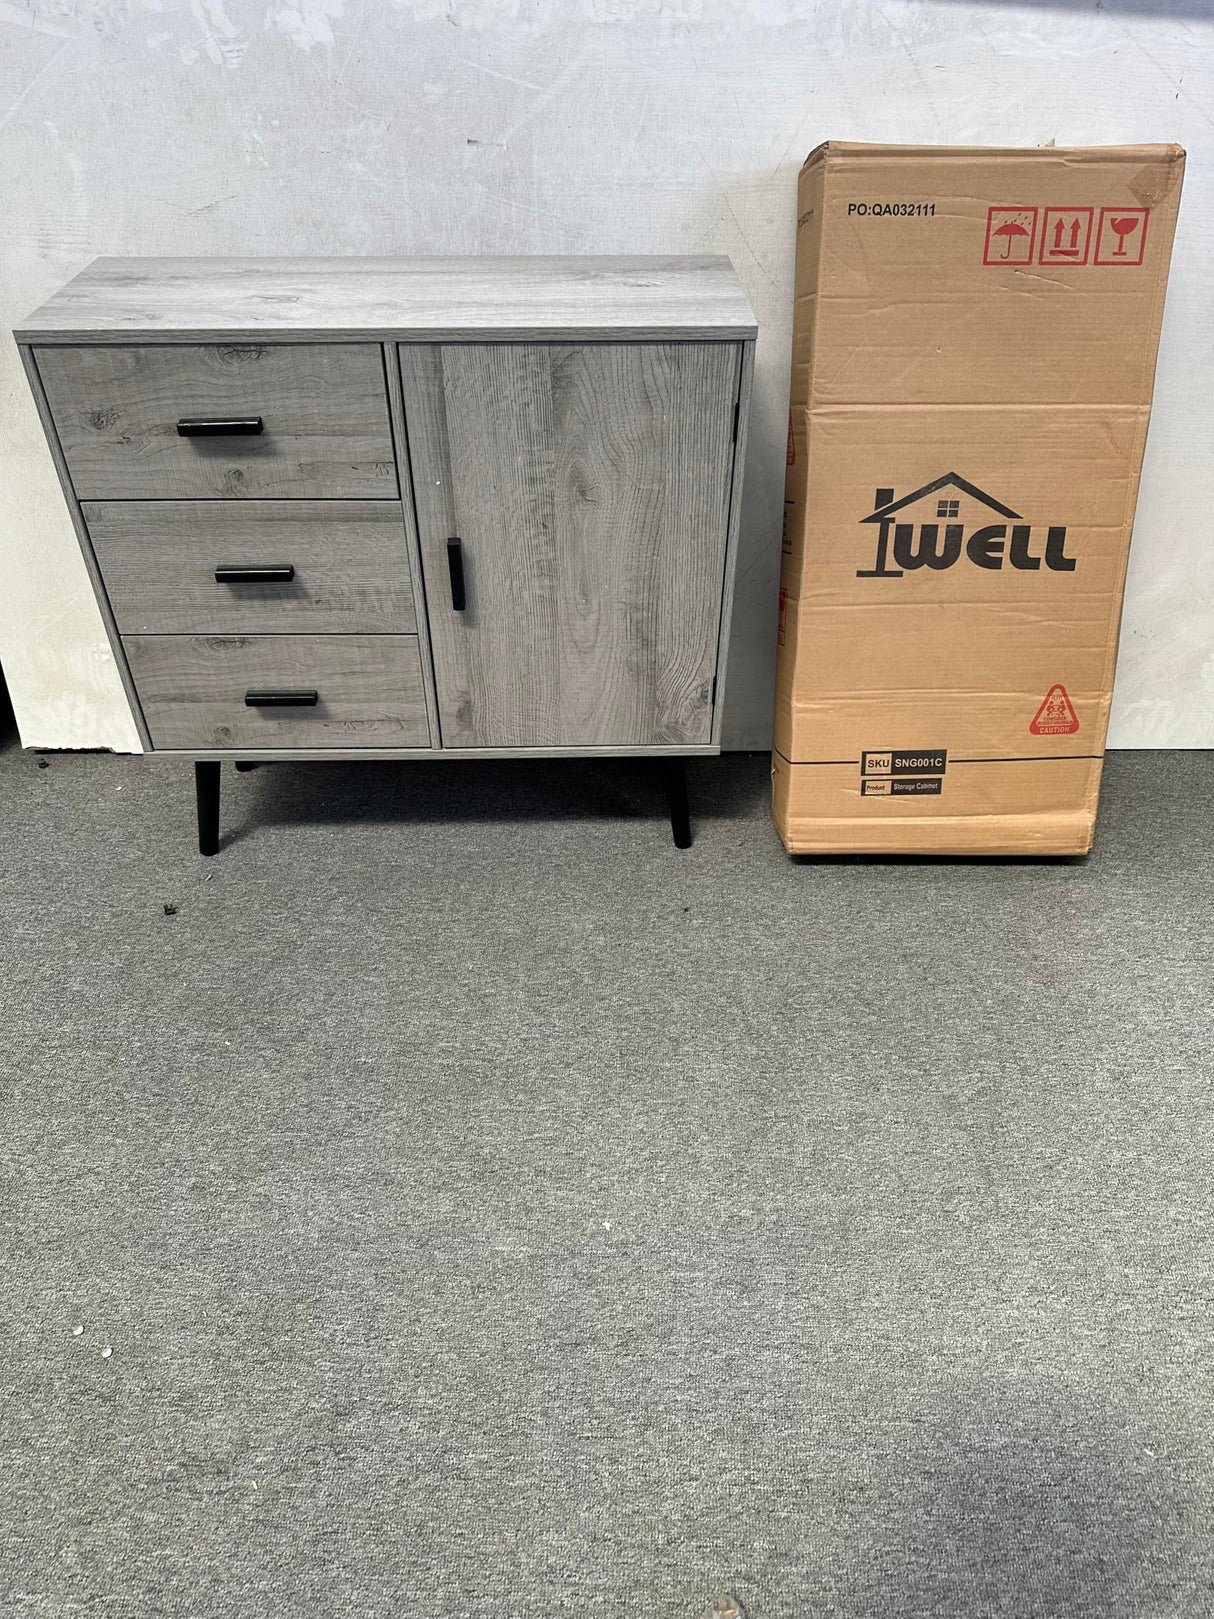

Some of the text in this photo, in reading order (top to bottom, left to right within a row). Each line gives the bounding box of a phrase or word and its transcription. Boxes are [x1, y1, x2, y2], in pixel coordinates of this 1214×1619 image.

[848, 203, 935, 216] PO:QA032111
[1039, 726, 1070, 734] CAUTION
[867, 758, 942, 768] SKU SNG001C
[893, 783, 915, 791] Storage
[916, 782, 938, 790] Cabinet
